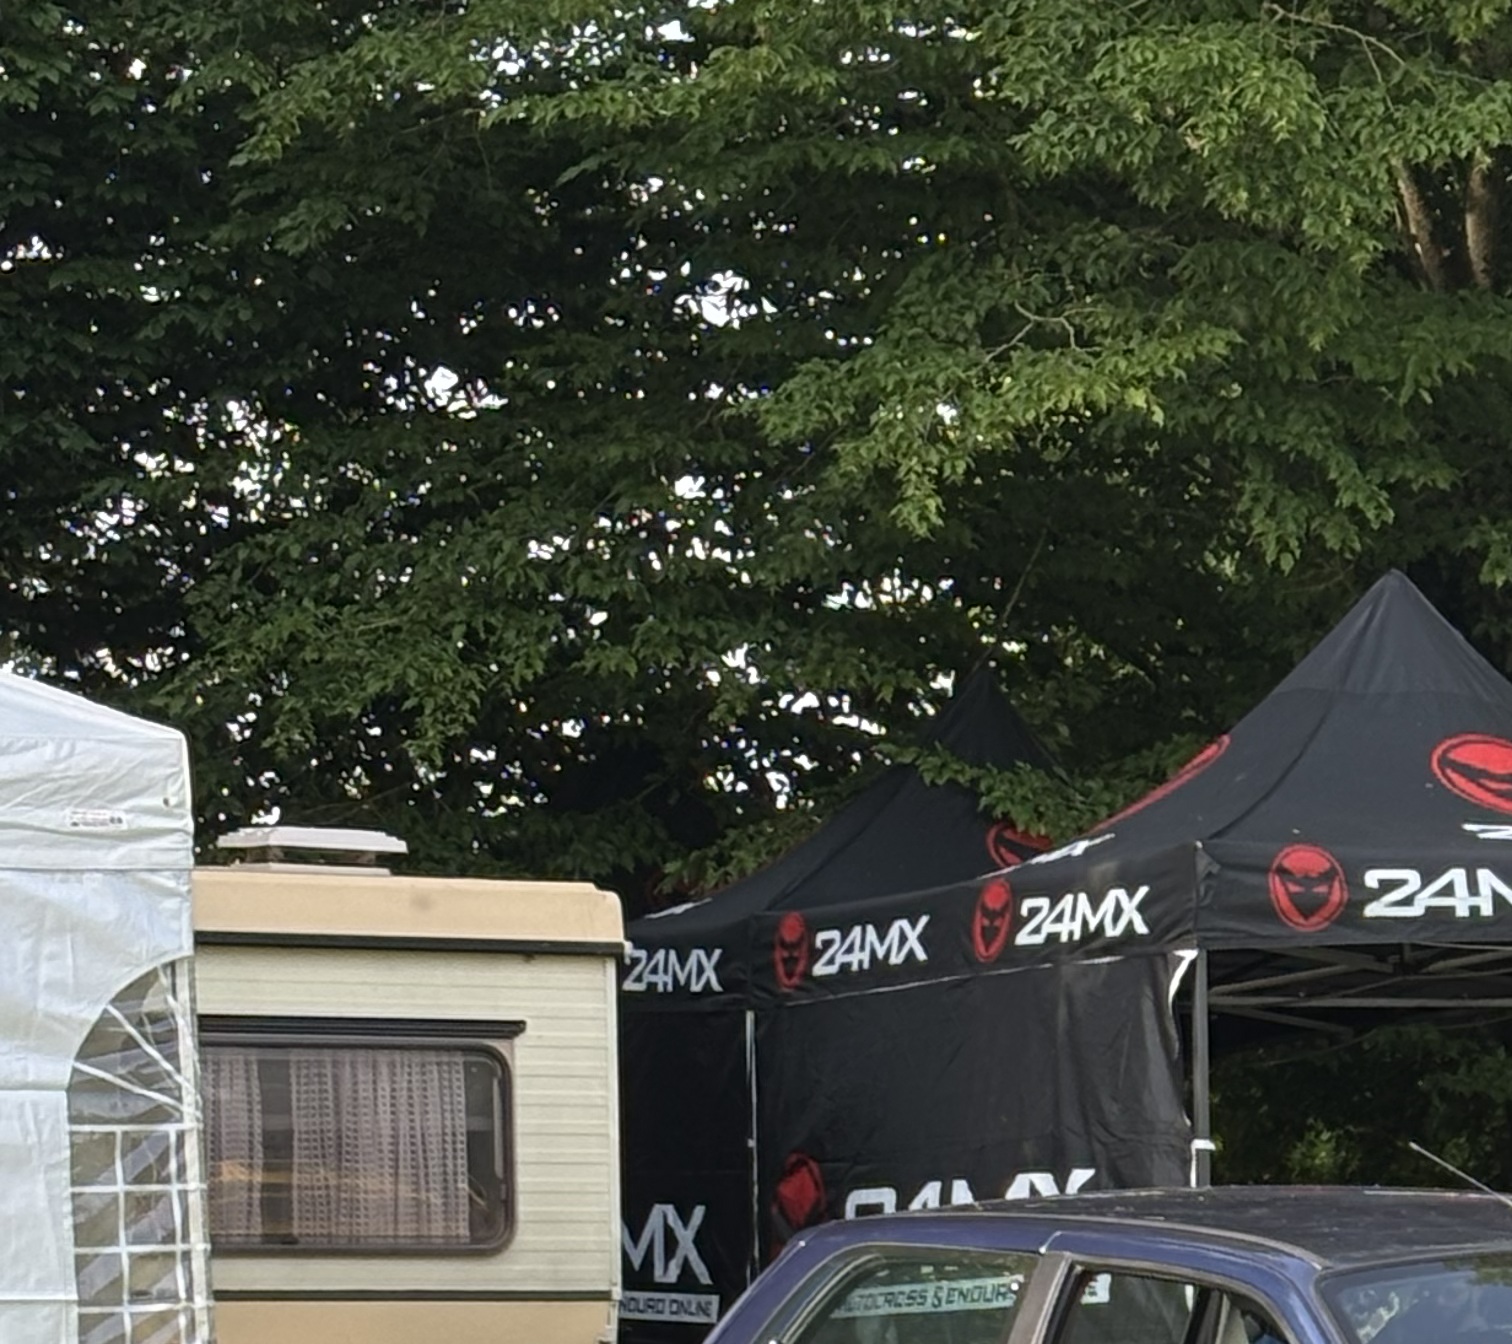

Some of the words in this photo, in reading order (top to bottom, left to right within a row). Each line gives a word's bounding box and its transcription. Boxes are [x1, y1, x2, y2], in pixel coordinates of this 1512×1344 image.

[812, 914, 931, 977] 24MX
[1014, 885, 1150, 947] 24MX
[622, 948, 724, 992] 24MX
